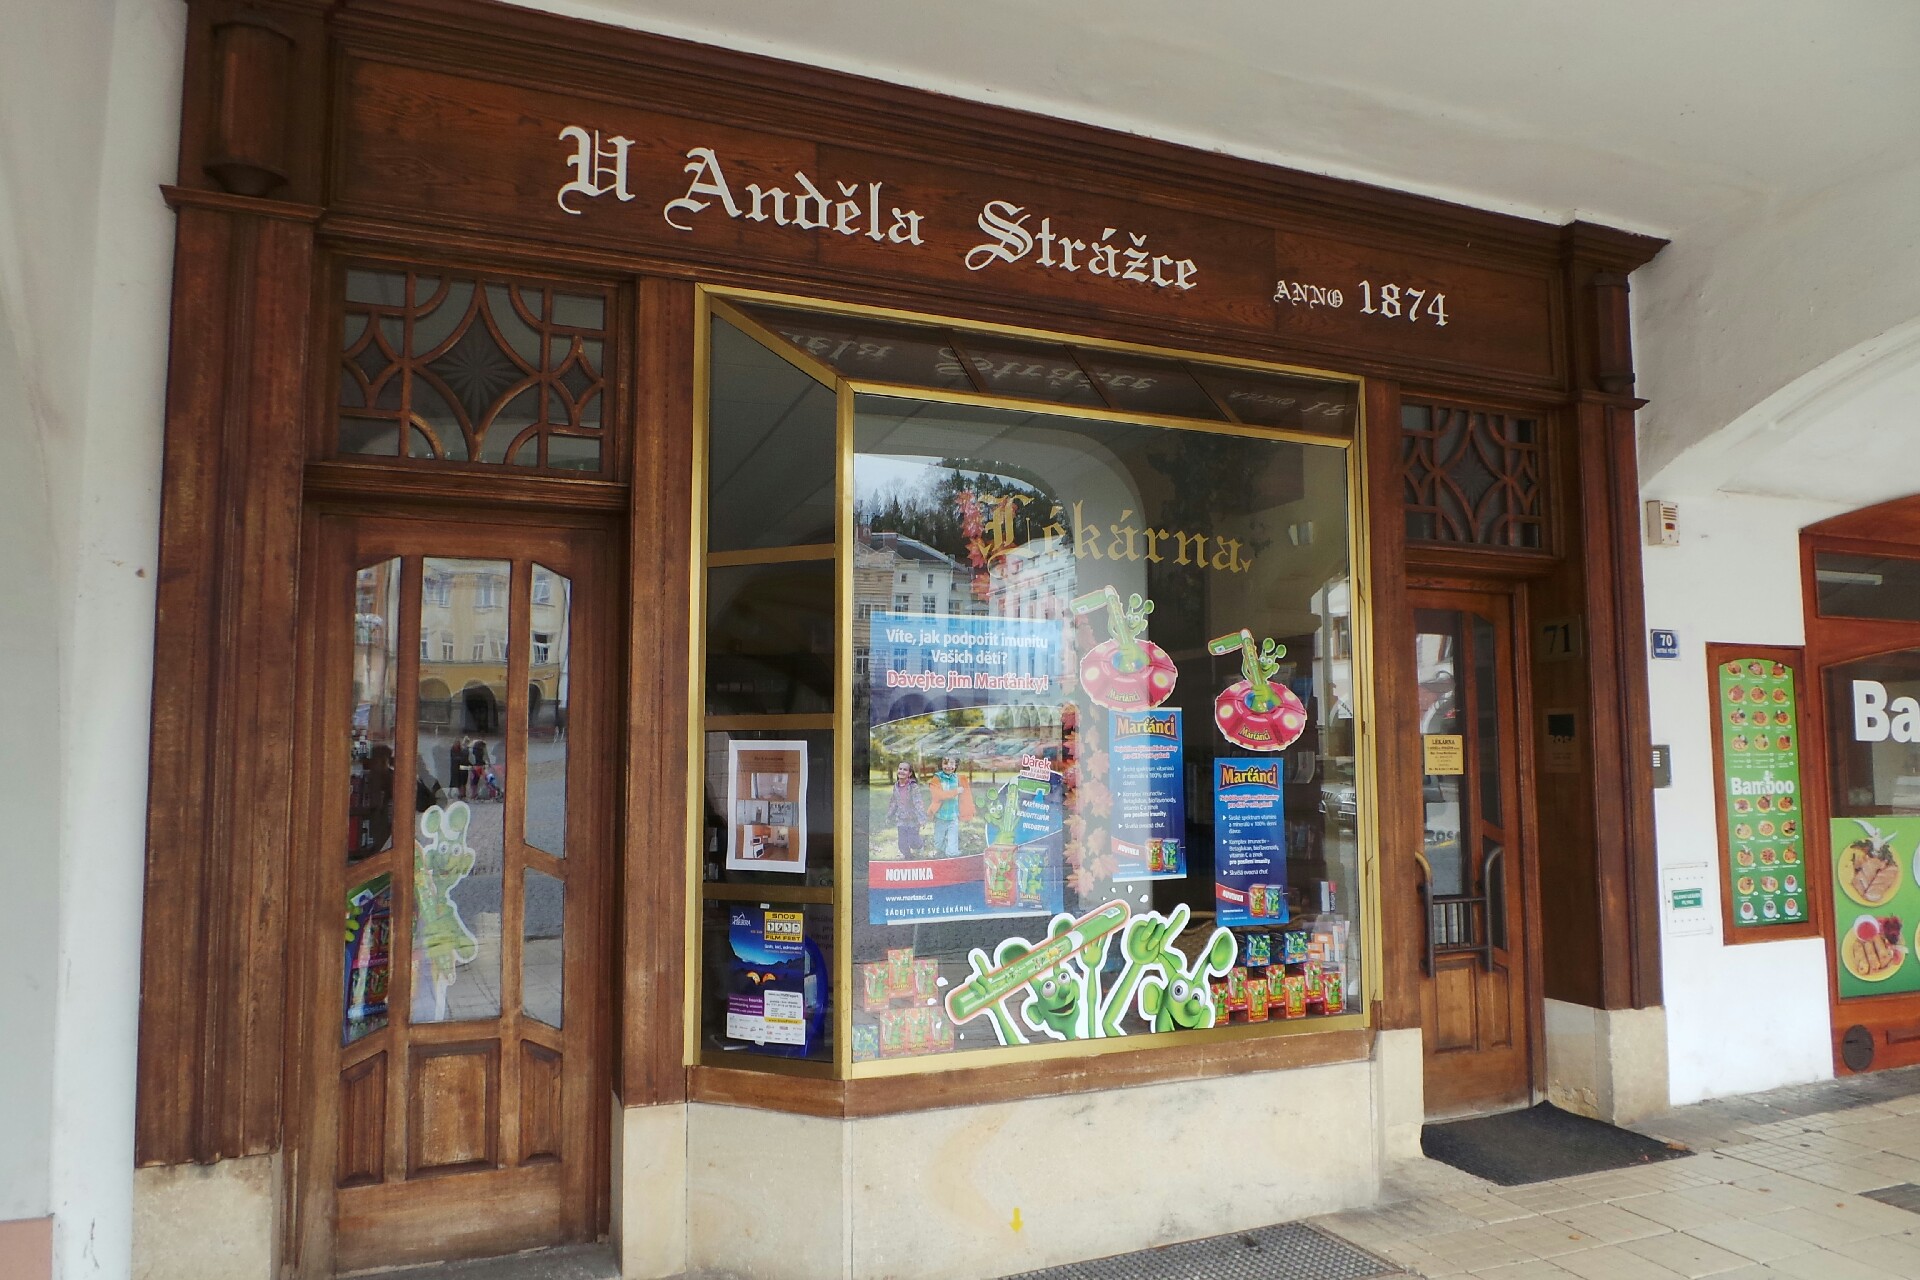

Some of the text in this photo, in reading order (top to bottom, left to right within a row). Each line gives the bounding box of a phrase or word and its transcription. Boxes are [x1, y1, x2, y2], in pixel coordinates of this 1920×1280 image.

[558, 126, 1198, 291] U Anděla Strážce
[1273, 279, 1450, 328] ANNO 1874
[977, 494, 1250, 579] Lékárna
[886, 628, 1049, 649] Víte, jak podpořit imunitu
[1543, 624, 1572, 655] 71
[1659, 634, 1673, 647] 70
[931, 650, 973, 664] Vašich
[886, 669, 1049, 694] Dávejte jim Marťánky!
[1117, 713, 1176, 738] Marťánci
[1022, 754, 1052, 770] Dárek
[1221, 766, 1277, 787] Marťánci
[1731, 770, 1795, 796] Bamboo
[885, 867, 934, 881] NOVINKA
[885, 906, 914, 917] ŽÁDEJTE
[916, 906, 926, 915] VE
[927, 904, 940, 914] SVÉ
